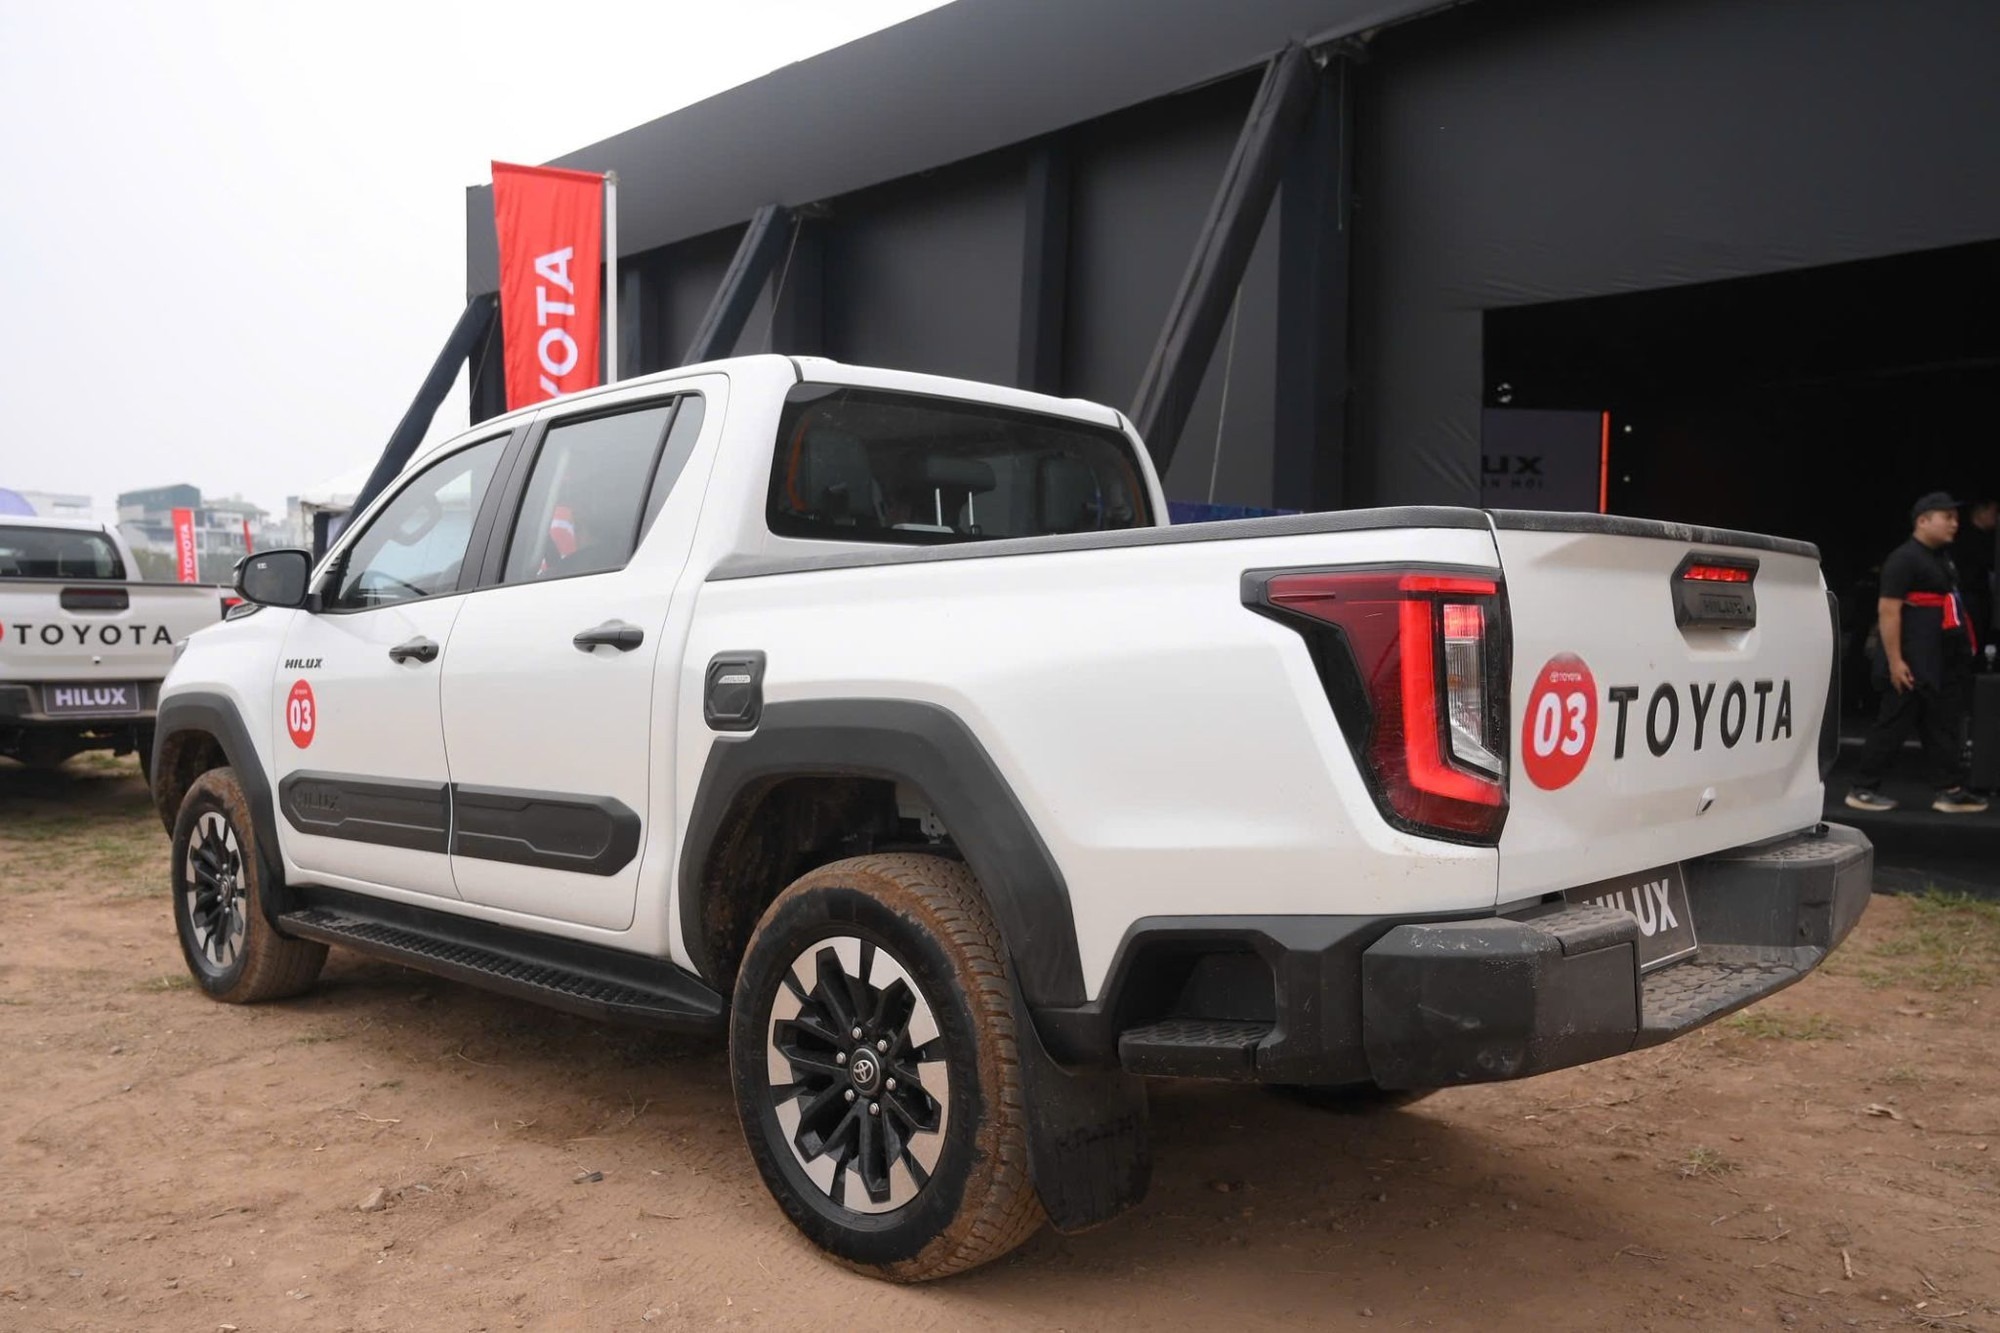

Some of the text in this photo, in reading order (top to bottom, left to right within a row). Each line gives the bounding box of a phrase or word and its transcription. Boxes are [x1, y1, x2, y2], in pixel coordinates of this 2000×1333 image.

[180, 523, 195, 575] TOYOTA
[13, 624, 173, 645] TOYOTA
[285, 658, 323, 669] HILUX
[55, 687, 127, 706] HILUX
[290, 699, 312, 732] 03
[1533, 691, 1588, 758] 03
[1608, 679, 1792, 760] TOYOTA
